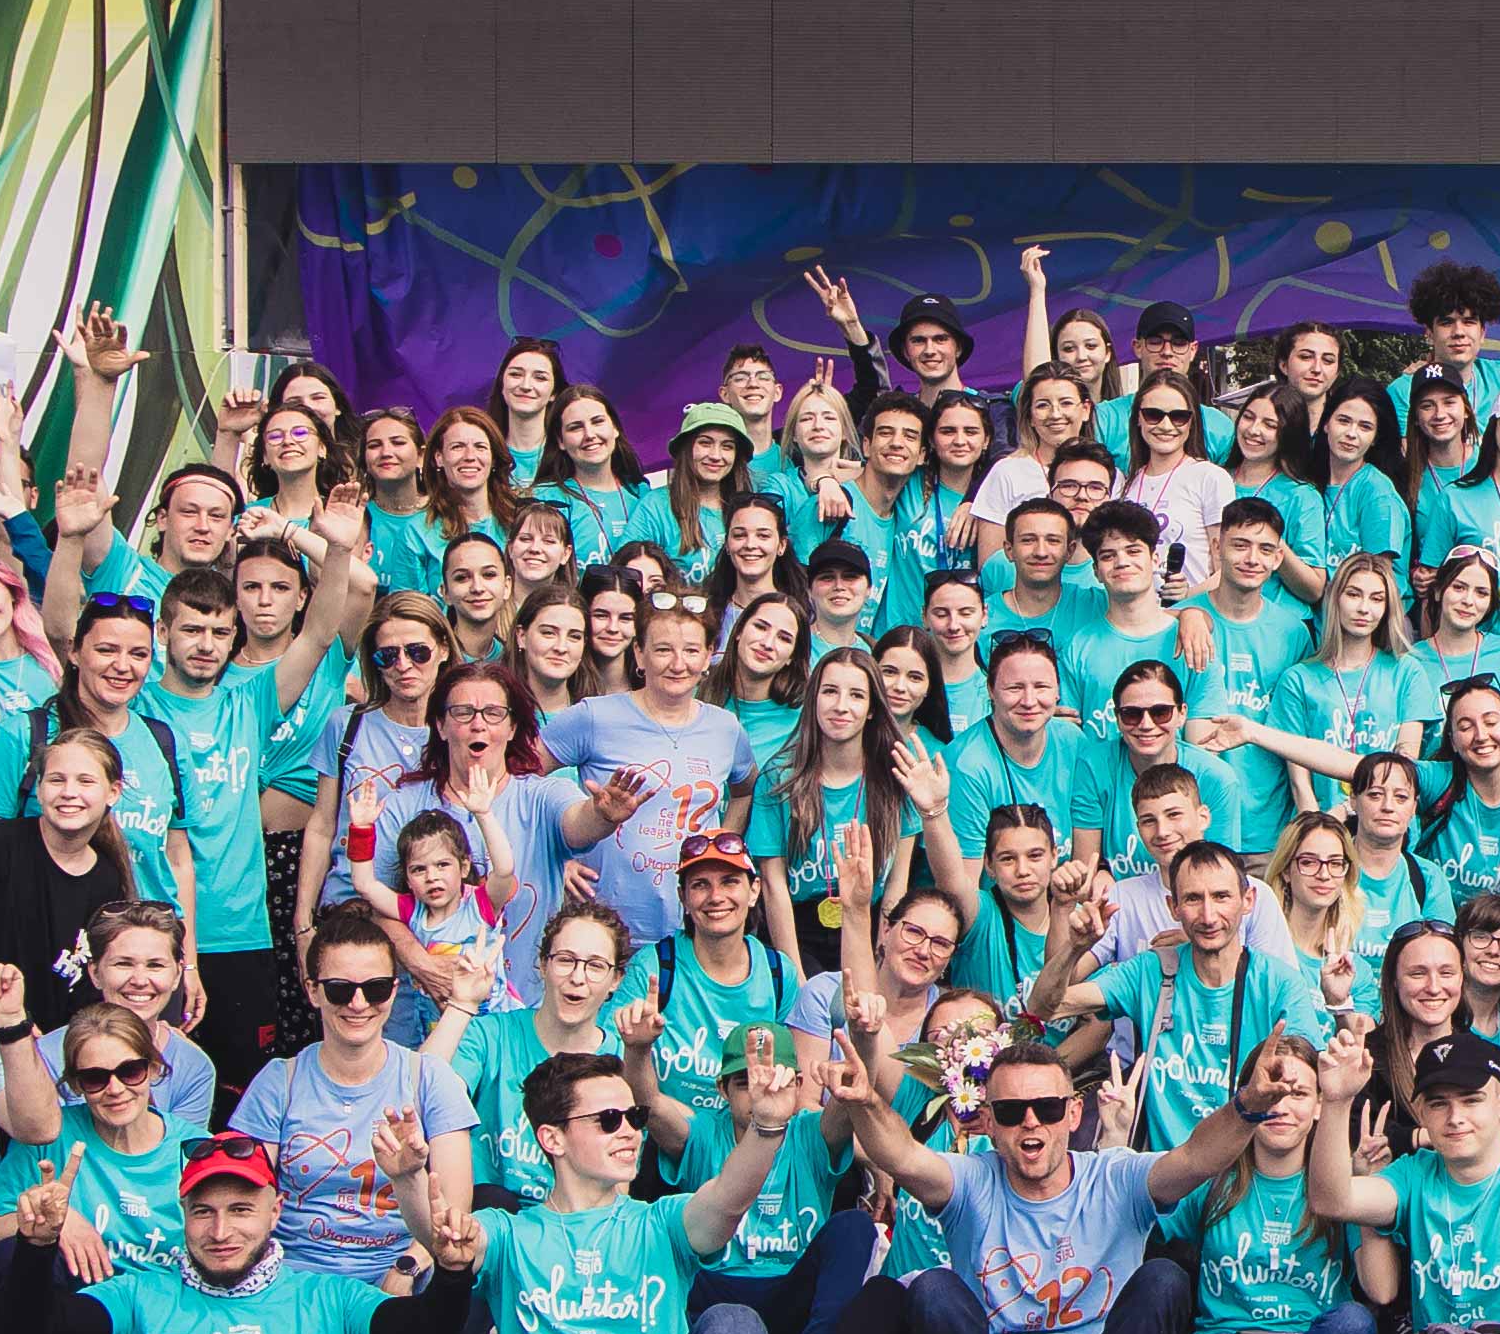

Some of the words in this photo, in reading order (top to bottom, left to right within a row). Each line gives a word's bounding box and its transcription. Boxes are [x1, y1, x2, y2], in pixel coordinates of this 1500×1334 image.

[120, 1203, 151, 1218] SIBIU
[1260, 1229, 1291, 1245] SIBIU
[1250, 1304, 1292, 1320] colt
[1449, 1305, 1486, 1326] colt
